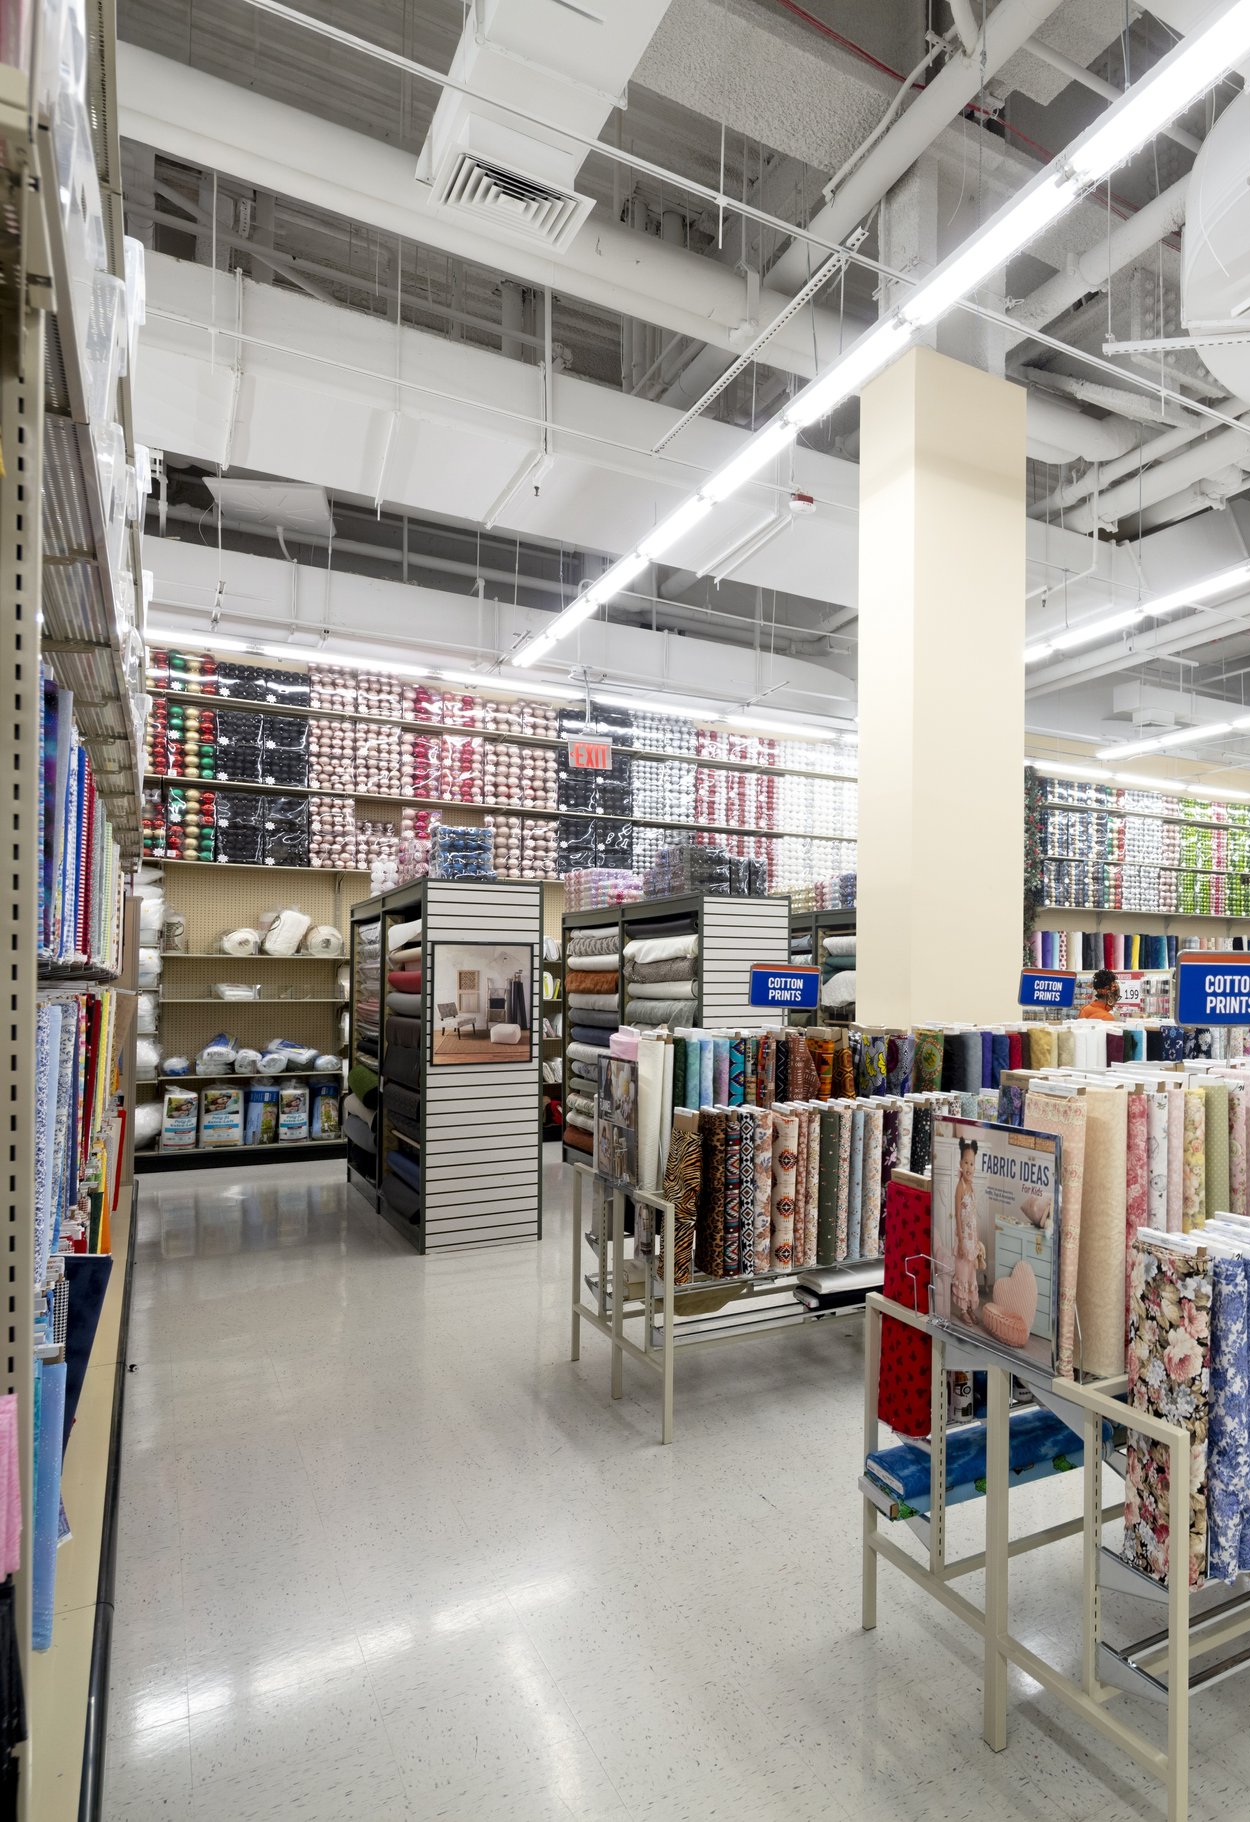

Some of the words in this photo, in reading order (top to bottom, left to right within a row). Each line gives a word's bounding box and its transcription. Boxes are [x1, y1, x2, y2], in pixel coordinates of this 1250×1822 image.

[574, 742, 608, 768] EXIT
[768, 977, 803, 989] COTTON
[1034, 980, 1062, 991] COTTON
[768, 989, 801, 1001] PRINTS
[1034, 991, 1060, 1001] PRINTS
[981, 1153, 1017, 1179] FABRIC
[1019, 1161, 1050, 1187] IDEAS
[1021, 1184, 1031, 1194] For
[1031, 1185, 1043, 1197] Kids
